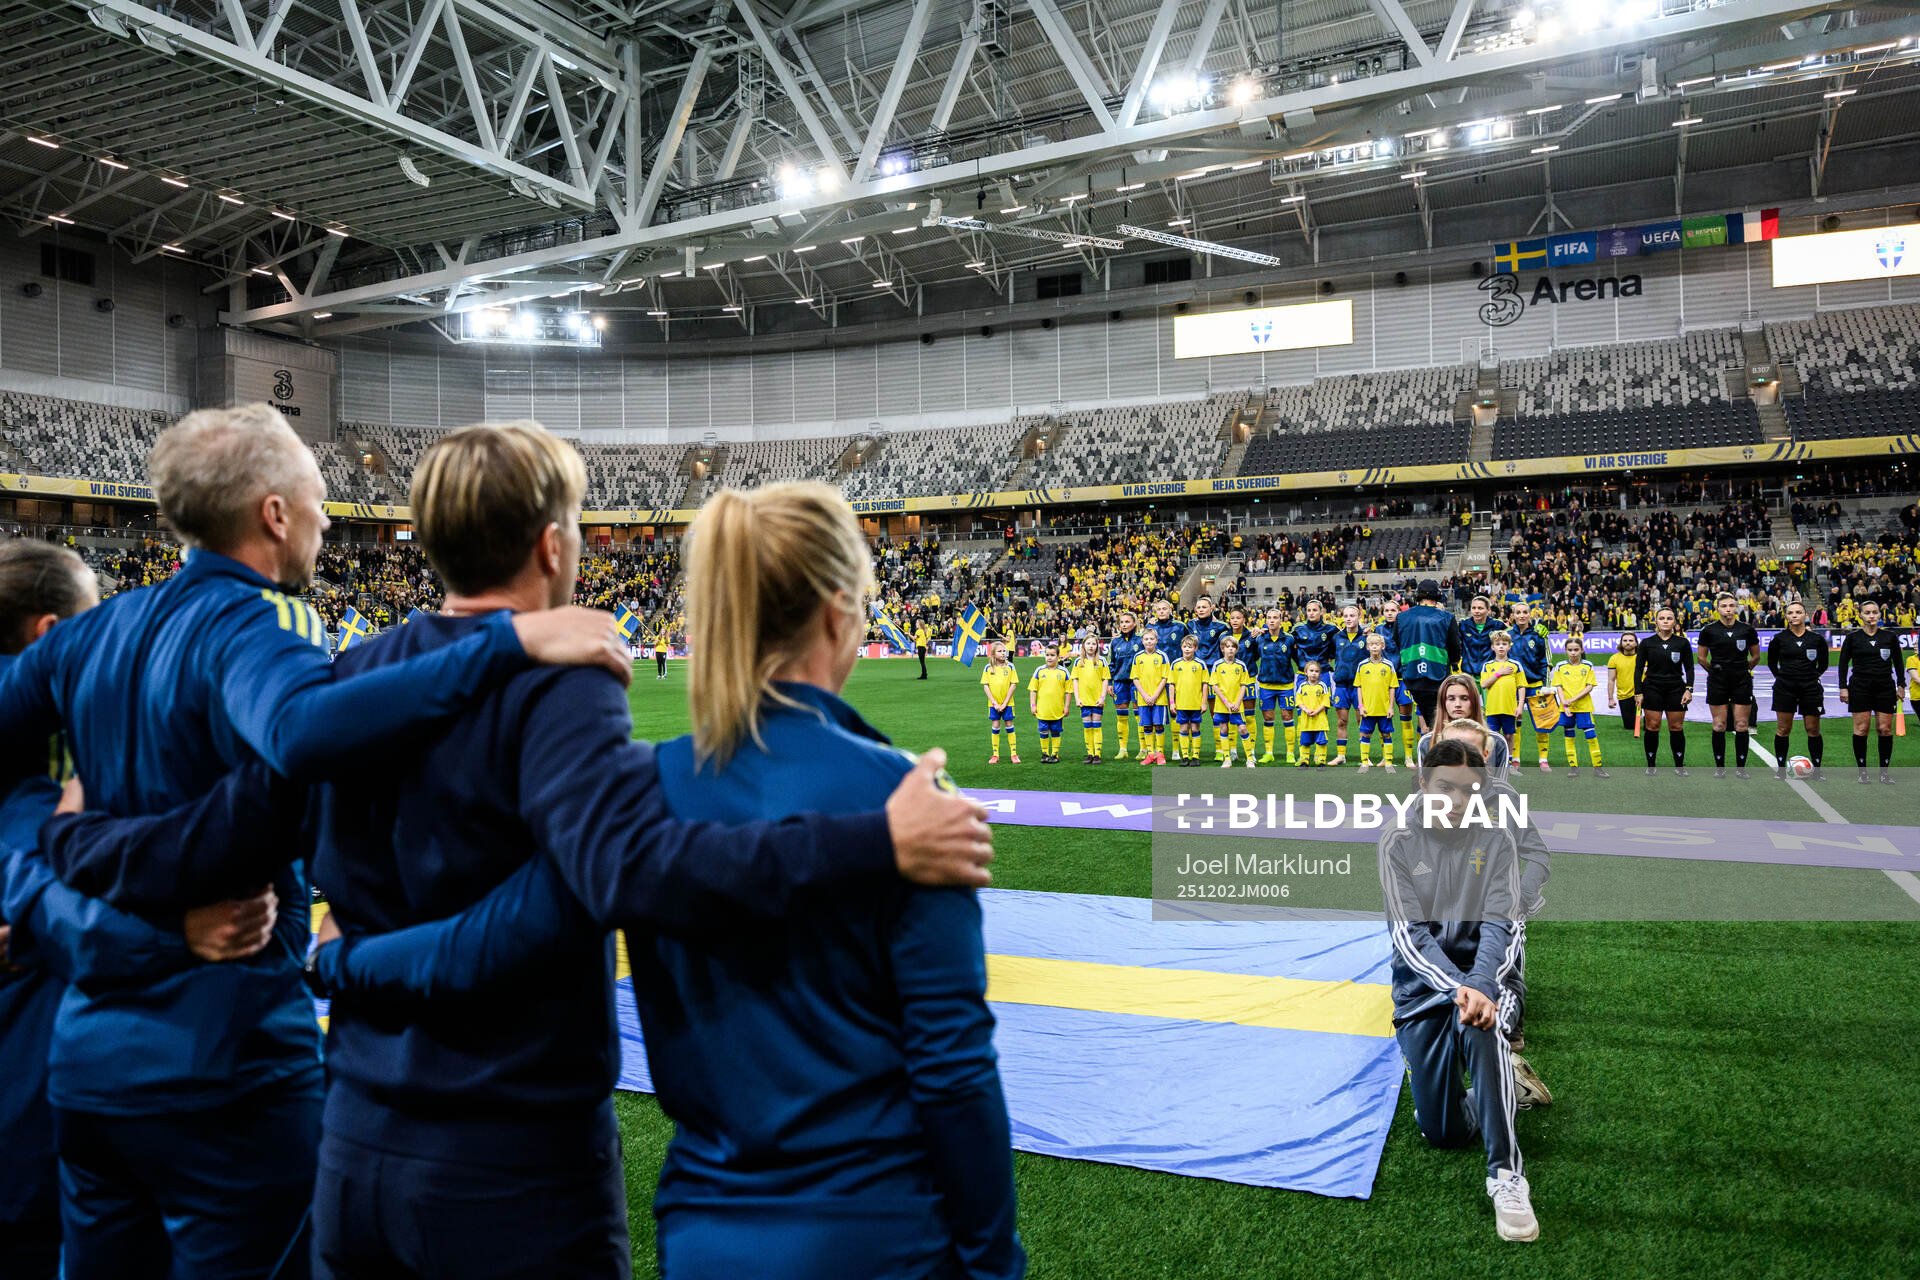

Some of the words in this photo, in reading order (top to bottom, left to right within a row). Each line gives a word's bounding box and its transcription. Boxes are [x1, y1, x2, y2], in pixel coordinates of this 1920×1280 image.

[1642, 230, 1680, 244] UEFA
[1554, 241, 1589, 257] FIFA
[1530, 274, 1643, 306] Arena
[1752, 366, 1770, 374] B307
[1583, 457, 1596, 469] VI
[1599, 455, 1615, 468] ÄR
[1617, 452, 1668, 467] SVERIGE
[90, 483, 100, 495] VI
[102, 483, 116, 497] ÄR
[118, 485, 155, 499] SVERIG
[1122, 485, 1133, 497] VI
[1134, 484, 1147, 496] ÄR
[1148, 482, 1187, 495] SVERIGE
[1212, 480, 1235, 491] HEJA
[1236, 476, 1280, 490] SVERIGE!
[871, 499, 906, 512] SVERIGE!
[1779, 542, 1800, 550] A107
[1284, 695, 1295, 707] 15
